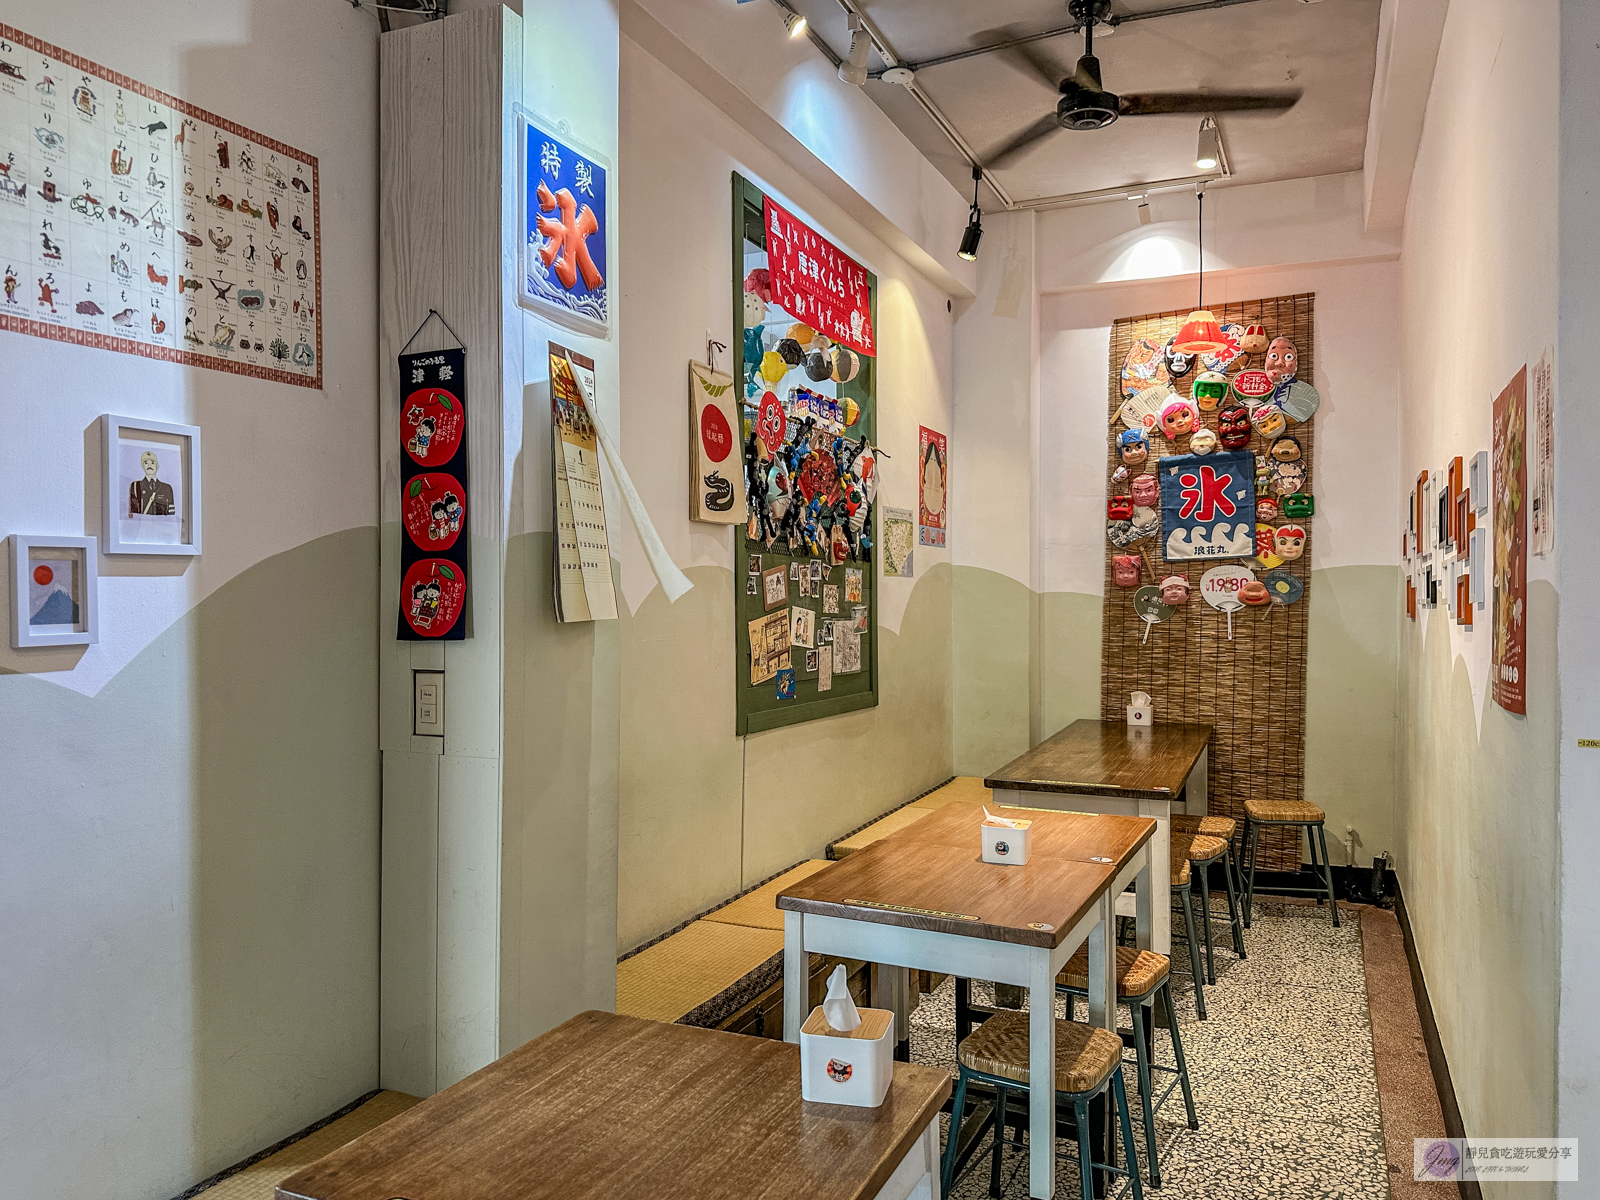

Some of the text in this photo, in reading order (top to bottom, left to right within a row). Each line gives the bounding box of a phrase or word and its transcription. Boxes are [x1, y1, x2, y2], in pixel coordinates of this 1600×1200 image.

[0, 40, 12, 52] わ
[42, 58, 49, 69] ら
[81, 76, 91, 86] や
[116, 88, 124, 101] ま
[148, 102, 158, 114] は
[44, 112, 51, 124] り
[117, 140, 127, 151] み
[150, 152, 159, 163] ひ
[44, 166, 52, 178] る
[183, 165, 192, 176] に
[297, 164, 303, 174] あ
[540, 142, 594, 198] 特製
[82, 178, 92, 190] ゆ
[215, 177, 221, 187] ち
[119, 191, 129, 202] む
[246, 189, 253, 199] し
[157, 203, 167, 214] ふ
[185, 212, 195, 222] ぬ
[42, 219, 53, 231] れ
[536, 178, 604, 292] 氷
[120, 242, 130, 252] め
[6, 264, 18, 276] ん
[185, 259, 194, 270] ね
[46, 272, 55, 284] ろ
[216, 270, 223, 280] て
[797, 250, 845, 299] 唐津くんち
[85, 282, 92, 293] よ
[247, 278, 255, 288] せ
[121, 290, 128, 302] も
[150, 298, 160, 309] ほ
[188, 307, 197, 317] の
[219, 314, 226, 324] と
[248, 321, 255, 332] そ
[299, 333, 306, 343] お
[412, 356, 446, 366] りんごのふる里
[412, 365, 454, 383] 津軽
[1179, 465, 1237, 523] 氷
